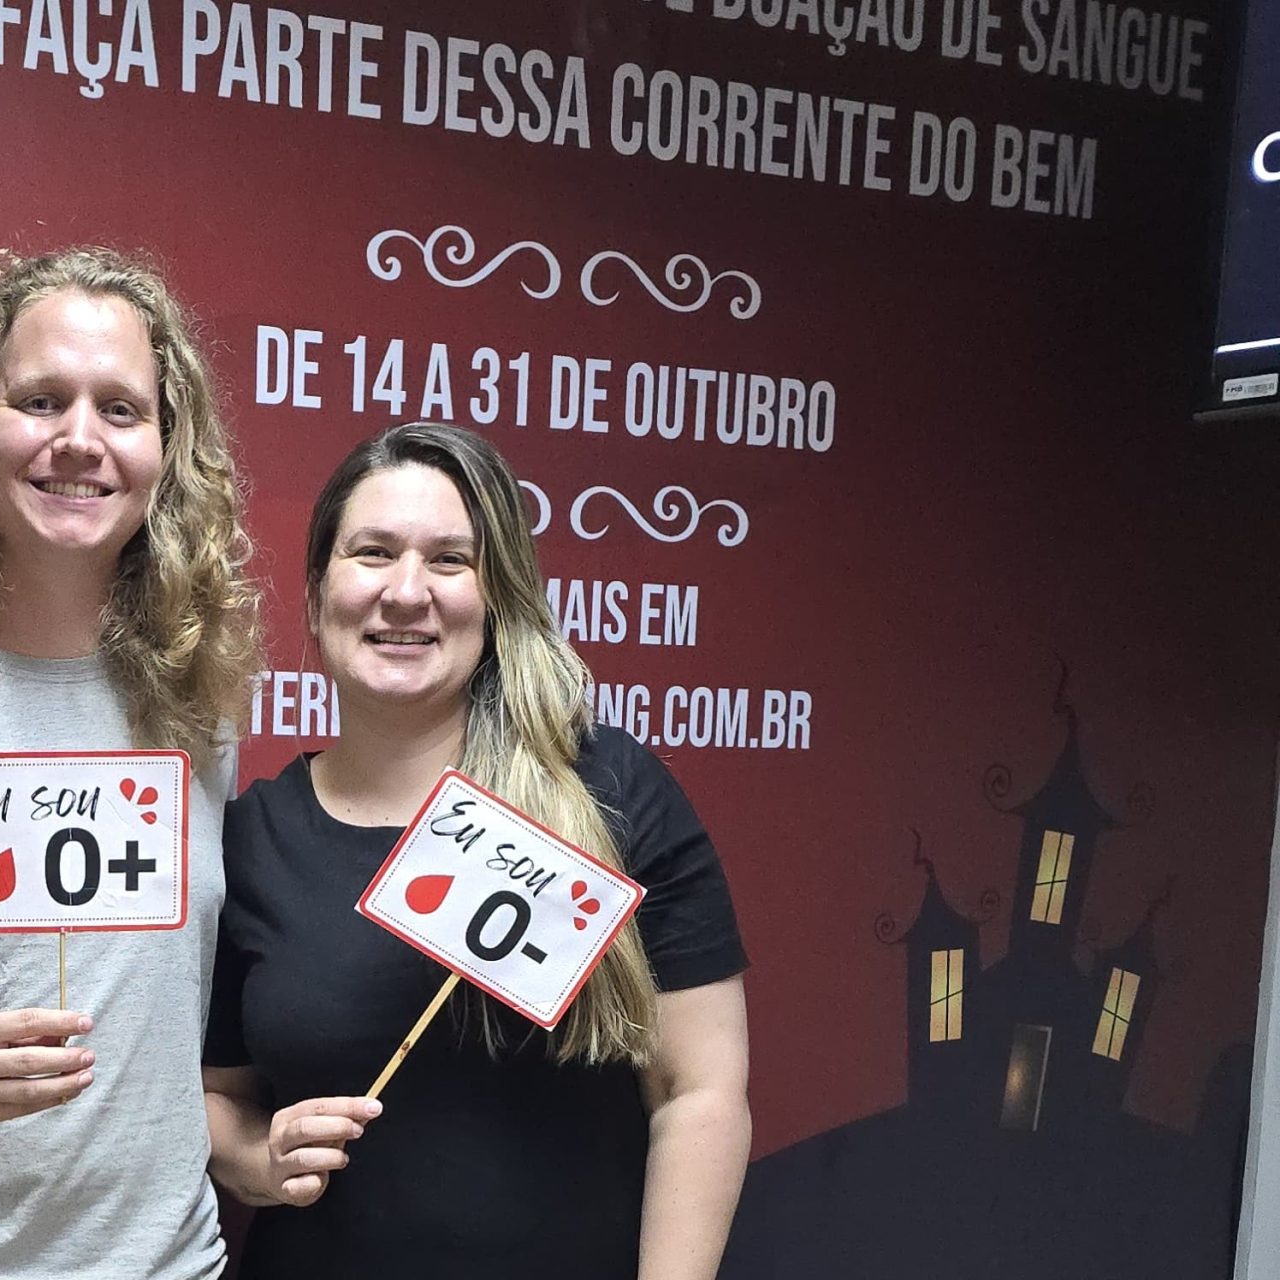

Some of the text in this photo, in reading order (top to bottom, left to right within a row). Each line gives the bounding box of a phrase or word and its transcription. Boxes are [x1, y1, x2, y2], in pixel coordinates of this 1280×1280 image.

[942, 0, 1003, 66] DE
[1018, 0, 1208, 100] SANGUE
[182, 0, 383, 119] PARTE
[403, 30, 590, 149] DESSA
[611, 63, 895, 191] CORRENTE
[909, 111, 977, 202] DO
[991, 124, 1097, 219] BEM
[255, 325, 836, 452] DE 14 A 31 DE OUTUBRO
[640, 584, 699, 647] EM
[30, 786, 101, 821] sou
[430, 801, 557, 898] Eu sou
